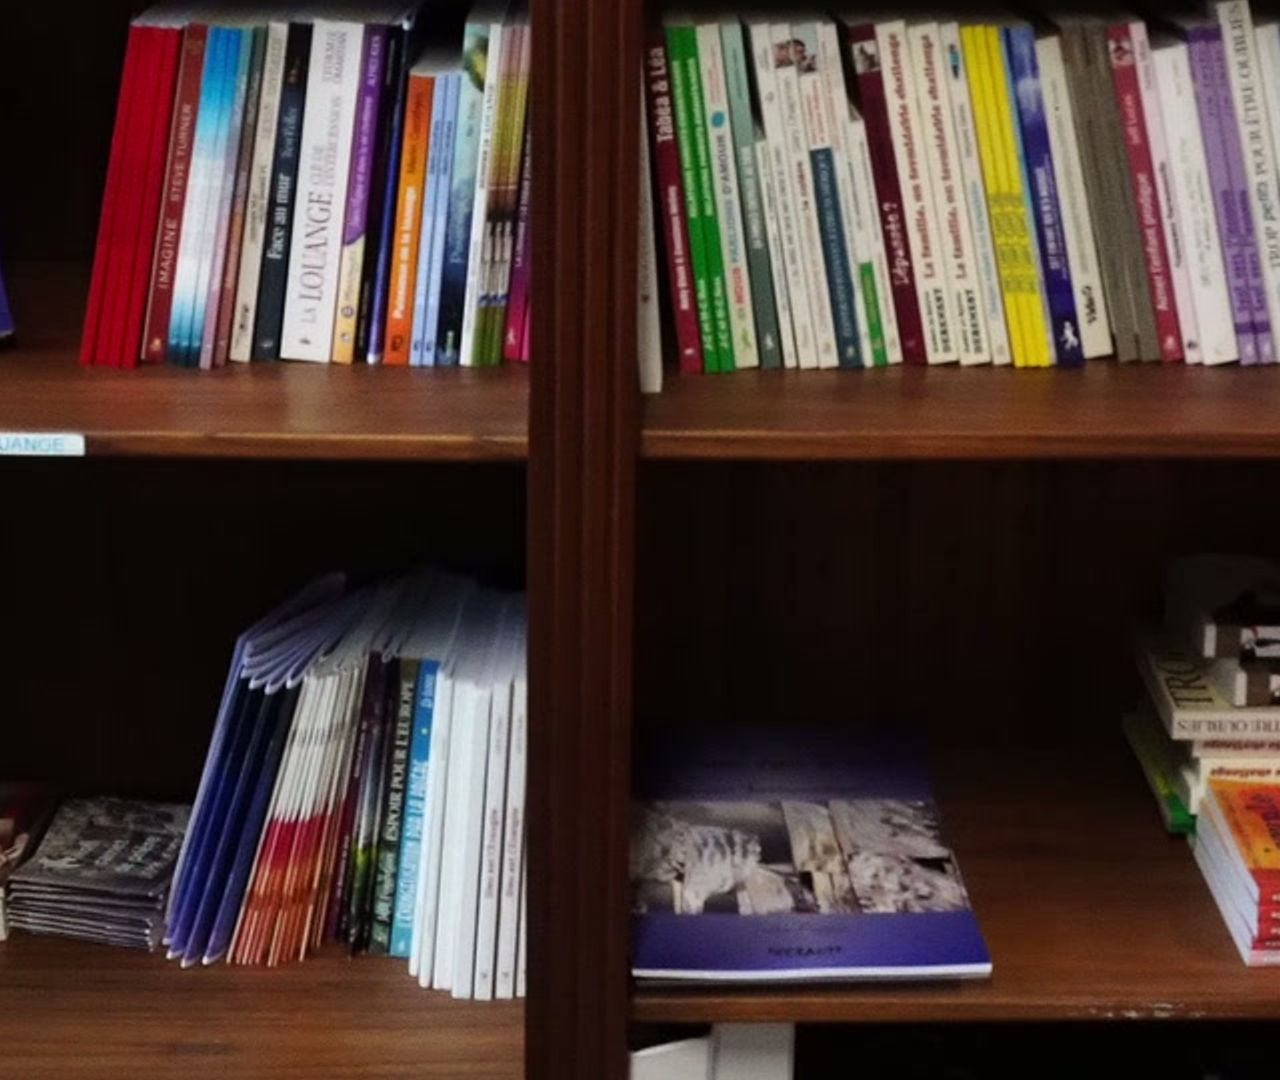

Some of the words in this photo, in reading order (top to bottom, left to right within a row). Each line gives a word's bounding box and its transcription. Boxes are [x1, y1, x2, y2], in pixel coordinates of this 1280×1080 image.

[652, 80, 668, 92] &
[173, 102, 194, 157] TURNER
[1247, 129, 1267, 176] POUR
[168, 161, 186, 202] STEVE
[274, 171, 293, 205] mur
[1136, 172, 1158, 226] prodigue
[272, 206, 288, 226] au
[156, 217, 179, 290] IMAGINE
[266, 227, 287, 260] Face
[303, 189, 335, 303] LOUANGE
[1150, 275, 1170, 312] Aimer
